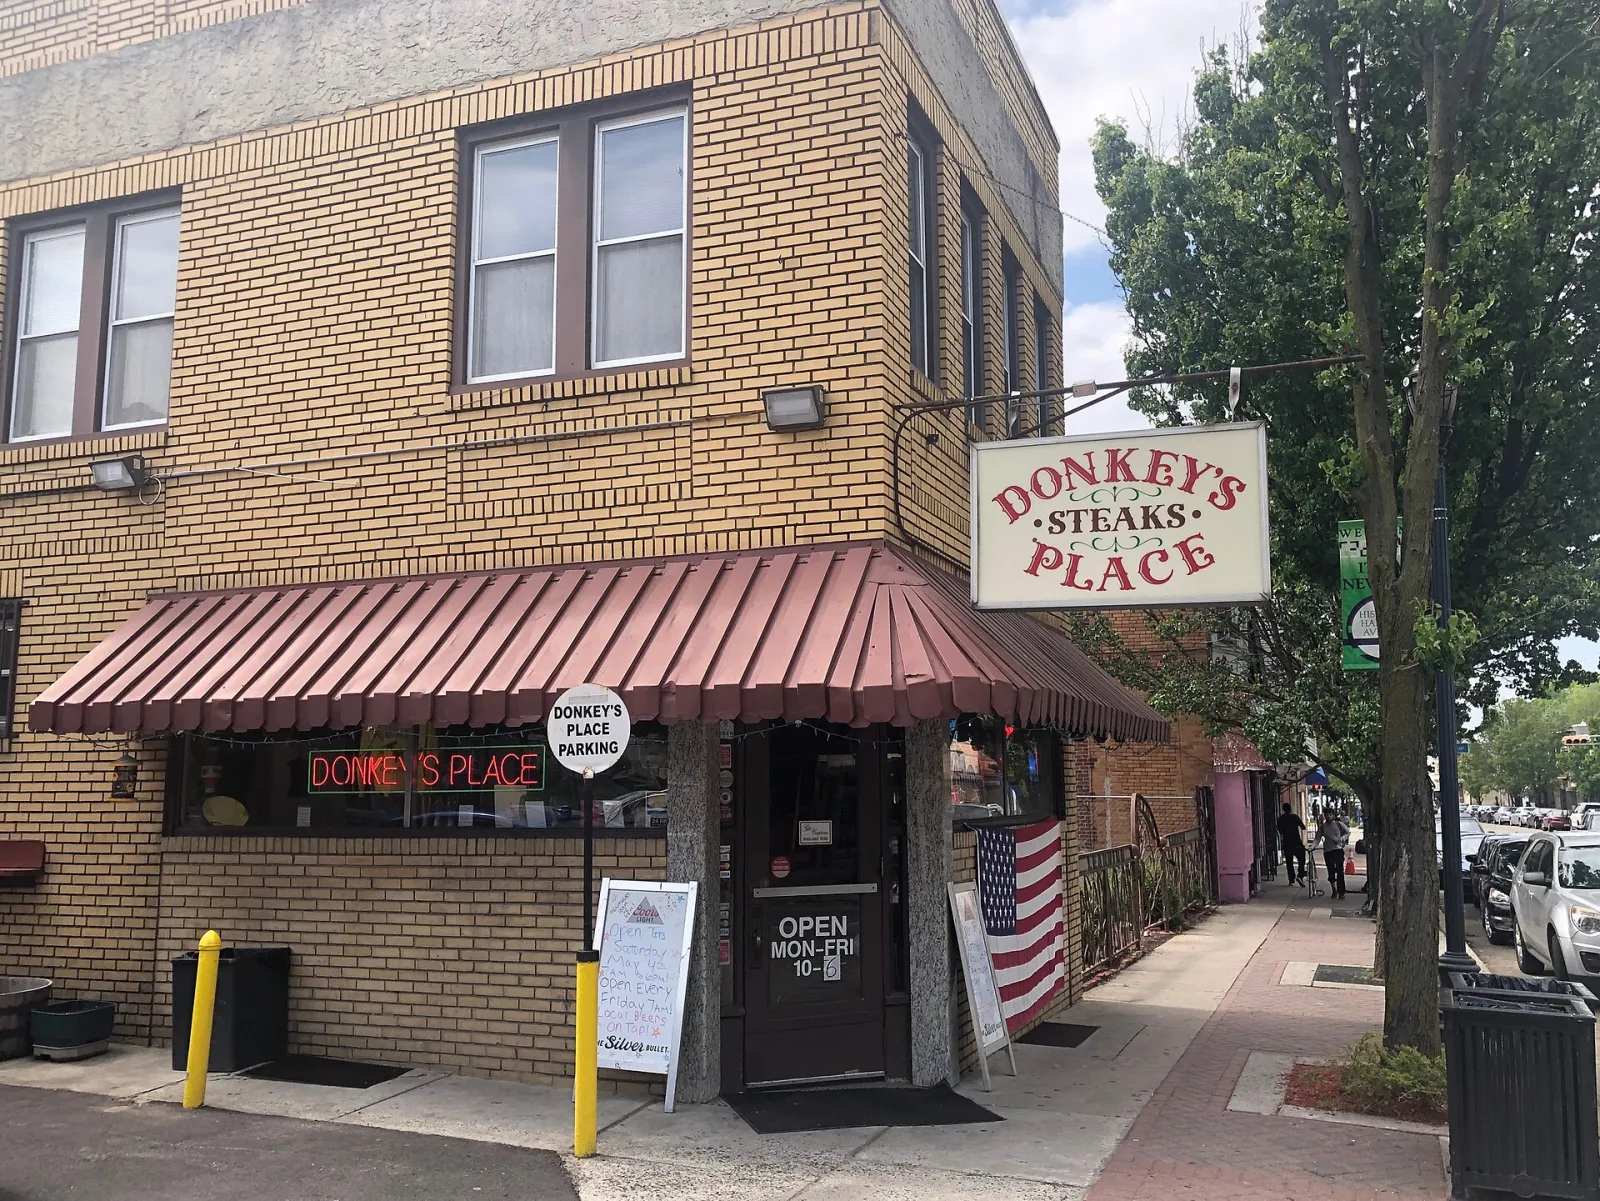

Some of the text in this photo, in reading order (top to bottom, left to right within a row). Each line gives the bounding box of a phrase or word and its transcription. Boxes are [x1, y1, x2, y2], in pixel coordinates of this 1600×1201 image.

[991, 448, 1247, 525] DONKEY'S
[1048, 503, 1186, 535] STEAKS
[1023, 533, 1216, 592] PLACE
[554, 704, 622, 719] DONKEY'S
[567, 722, 610, 737] PLACE
[558, 741, 619, 757] PARKING
[450, 753, 539, 785] PLACE
[633, 905, 660, 918] Coors
[609, 923, 642, 940] Open
[779, 915, 847, 938] OPEN
[771, 938, 854, 959] MON-FRI
[607, 955, 640, 972] May
[600, 991, 645, 1011] Friday
[634, 1010, 667, 1027] Beers
[604, 1035, 645, 1052] Silver
